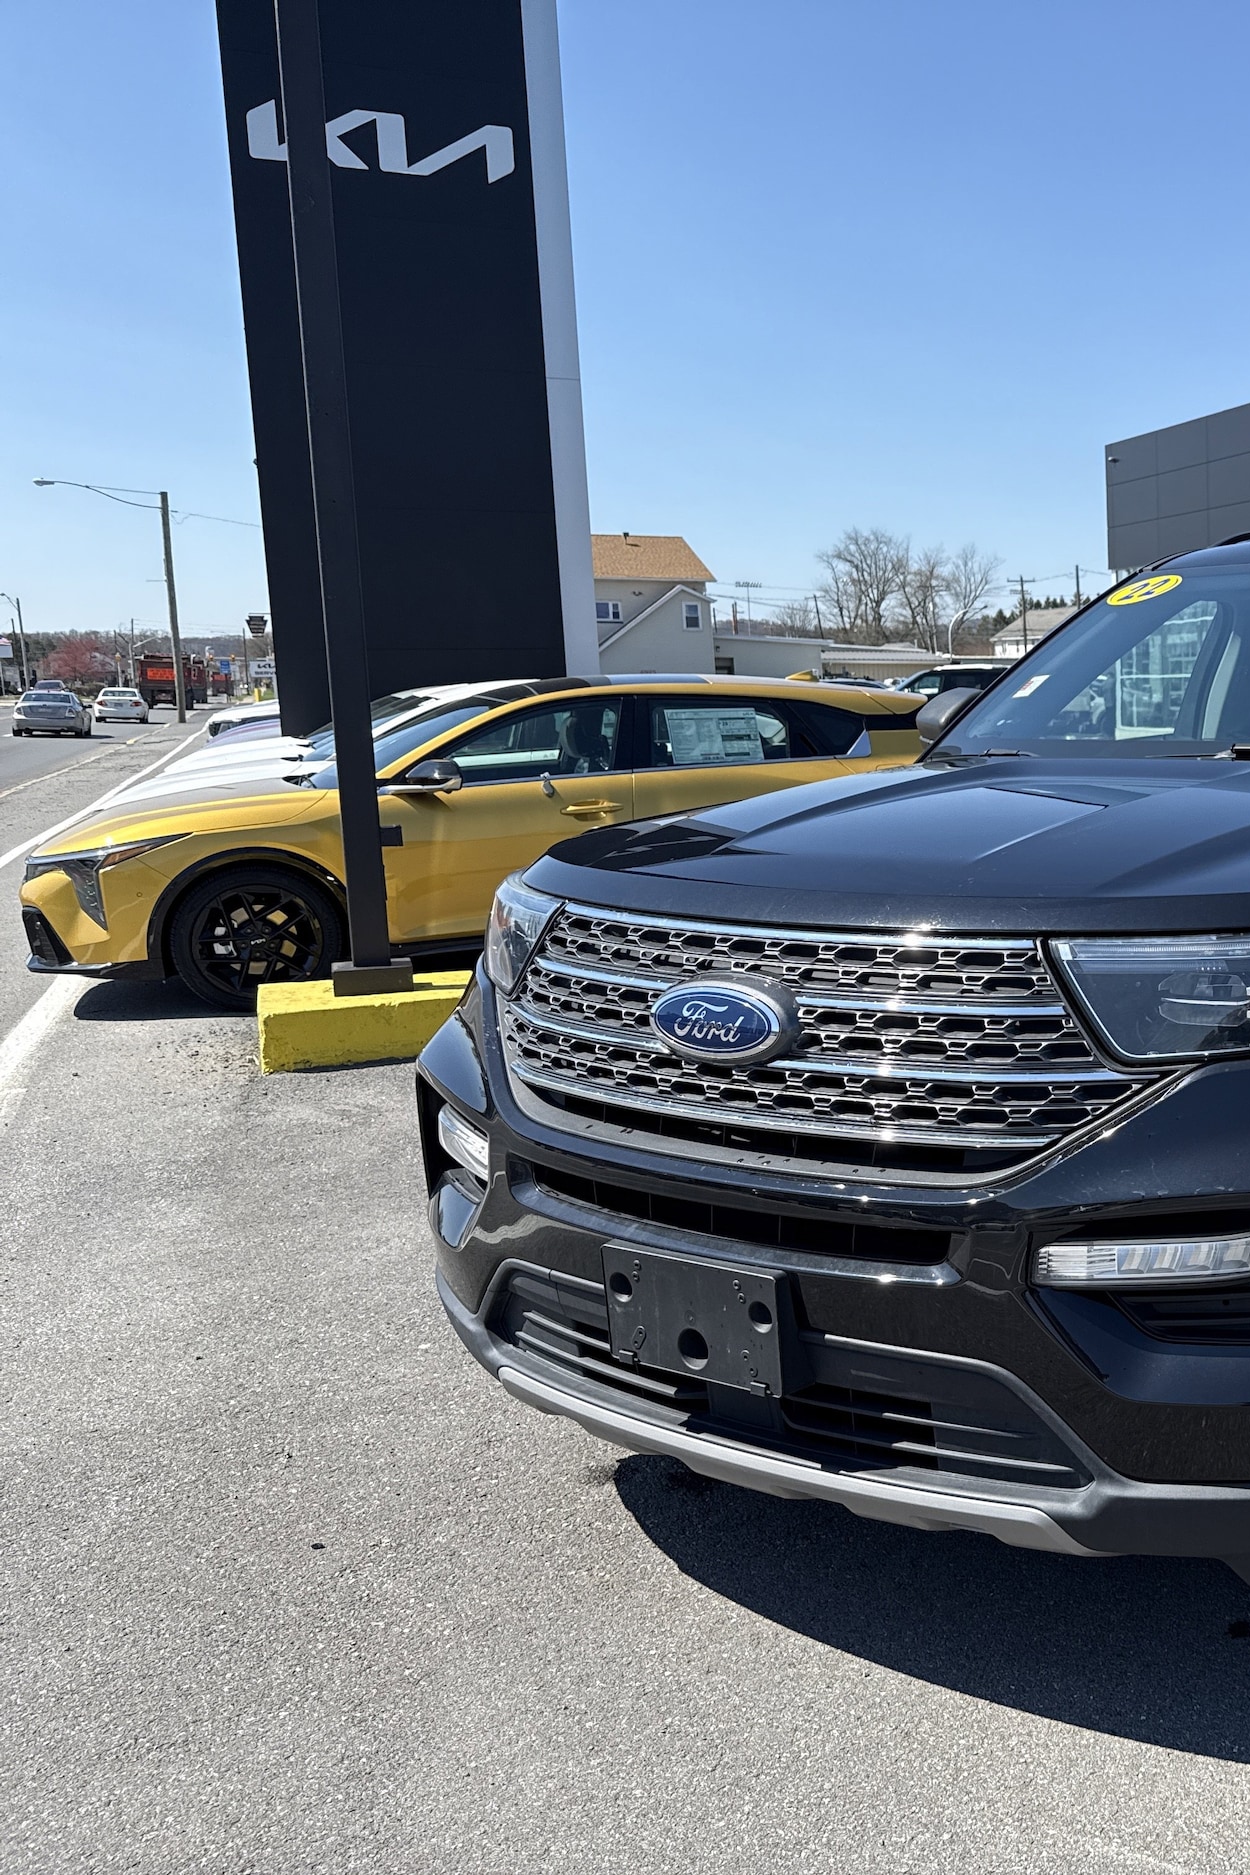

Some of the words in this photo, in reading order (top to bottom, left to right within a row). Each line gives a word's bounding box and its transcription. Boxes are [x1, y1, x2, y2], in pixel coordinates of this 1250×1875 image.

[246, 99, 515, 184] KIA
[1116, 578, 1172, 602] 22
[673, 1000, 745, 1043] Ford
